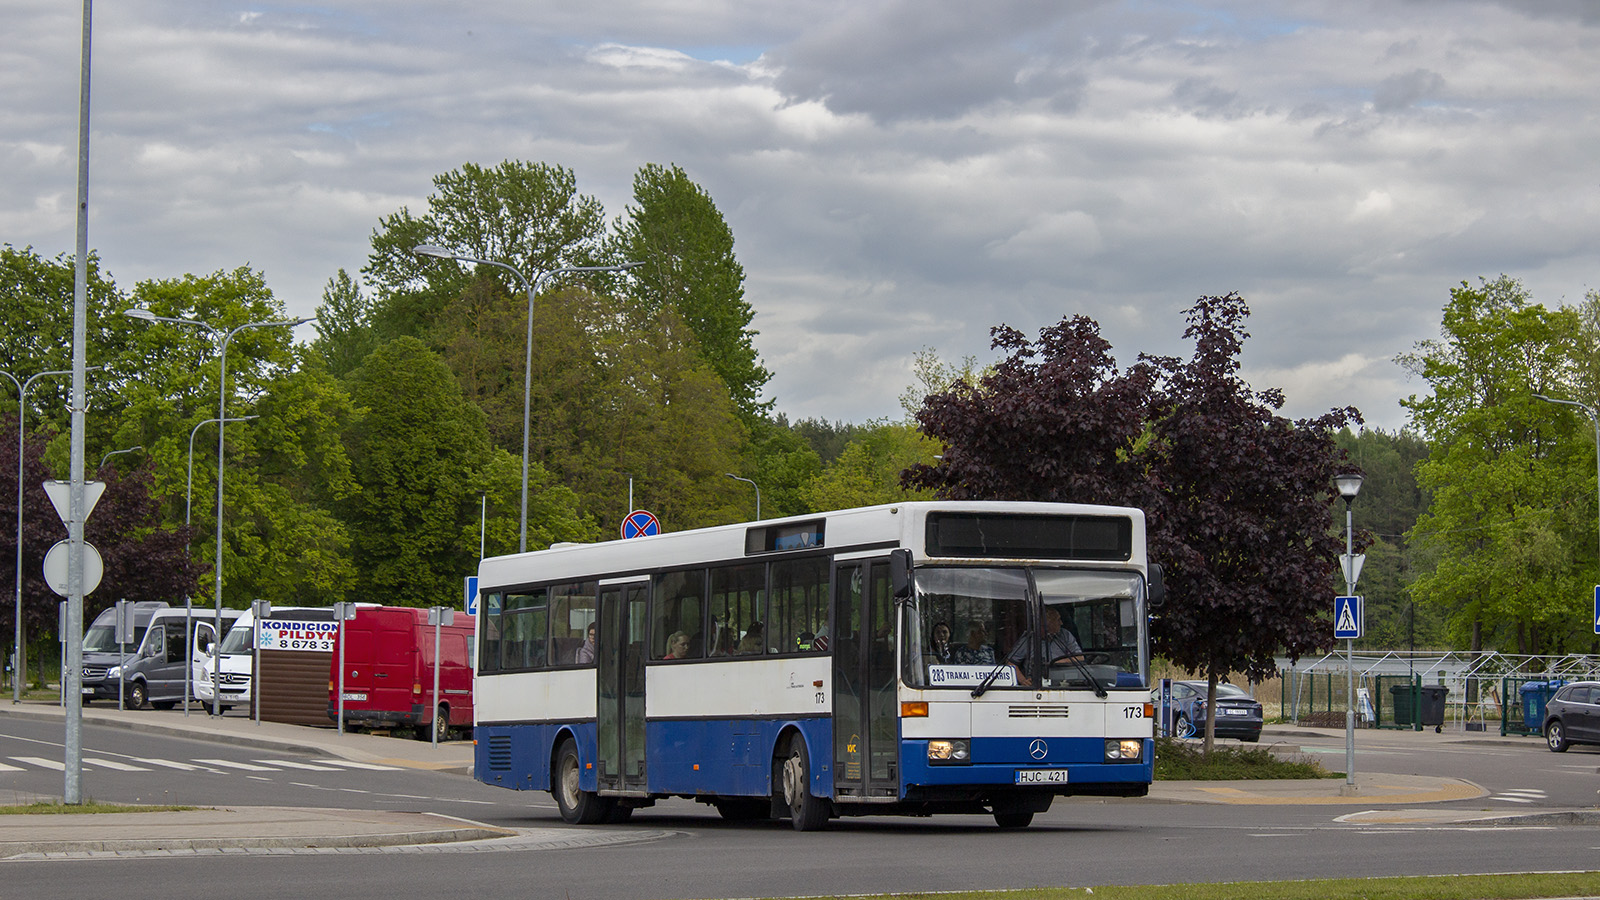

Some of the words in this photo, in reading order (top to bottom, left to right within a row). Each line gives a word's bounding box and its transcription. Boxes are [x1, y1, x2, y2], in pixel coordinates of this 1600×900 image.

[280, 640, 288, 648] 8
[291, 640, 317, 649] 678
[932, 669, 945, 682] 283
[946, 671, 970, 680] TRAKAI
[815, 692, 825, 703] 173
[1123, 706, 1142, 718] 173
[1020, 772, 1042, 781] HJC
[1048, 771, 1066, 781] 421
